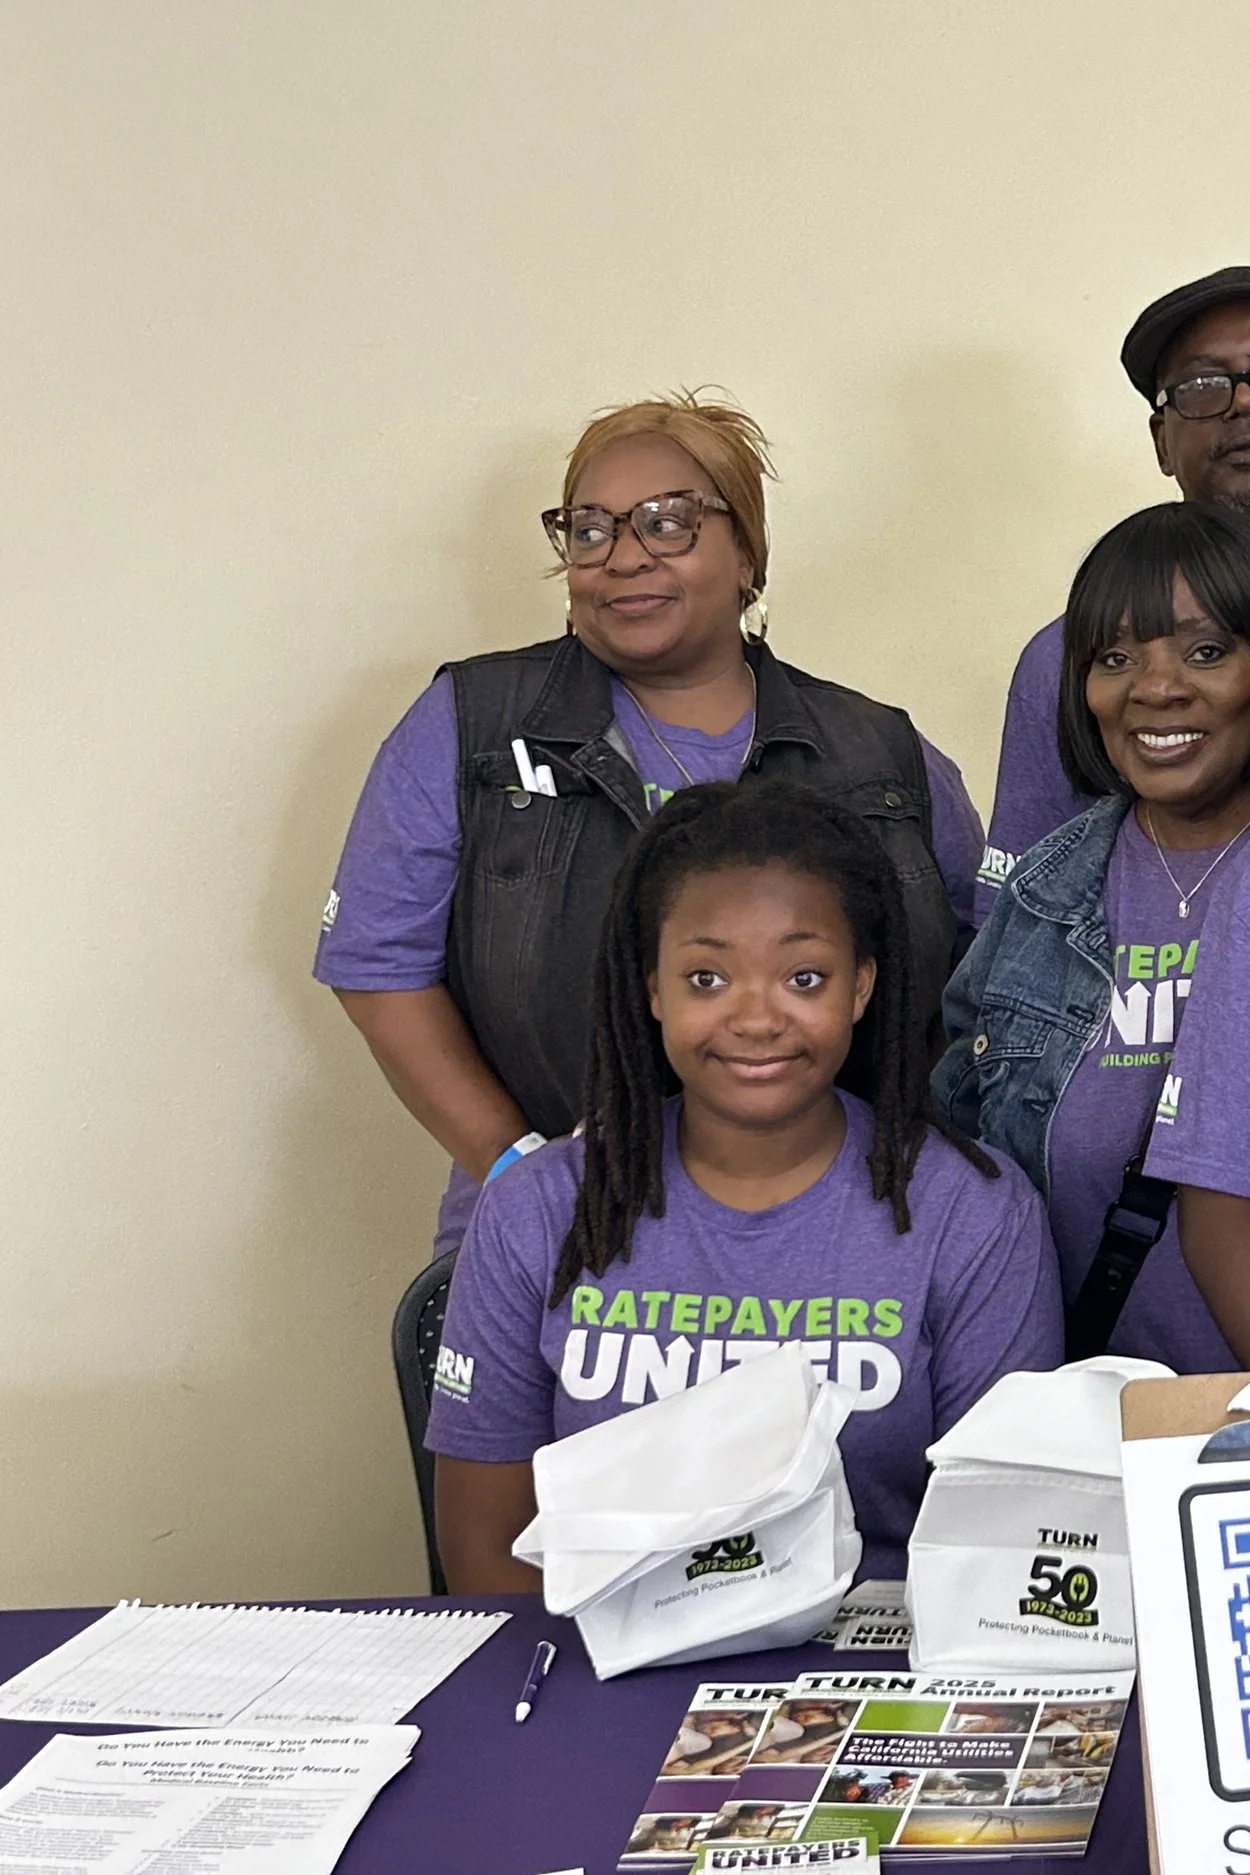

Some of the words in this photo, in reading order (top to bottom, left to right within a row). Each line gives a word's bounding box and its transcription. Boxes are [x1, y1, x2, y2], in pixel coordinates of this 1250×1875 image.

[572, 1285, 903, 1338] RATEPAYERS
[1038, 1528, 1099, 1547] TURN
[1027, 1554, 1099, 1610] 50
[1026, 1601, 1093, 1623] 1973-2023
[978, 1617, 1030, 1635] Protecting
[1031, 1624, 1090, 1641] Pocketbook
[805, 1676, 917, 1689] TURN
[919, 1686, 1017, 1697] Annual
[1022, 1685, 1117, 1698] Report
[154, 1740, 192, 1748] Have
[224, 1739, 275, 1748] Energy
[848, 1745, 938, 1757] California
[852, 1737, 885, 1746] The
[888, 1738, 935, 1748] Fight
[940, 1740, 958, 1748] to
[961, 1739, 1011, 1749] Make
[218, 1762, 269, 1774] Energy
[302, 1765, 343, 1774] Need
[712, 1840, 861, 1858] RATEPAYERS
[712, 1847, 861, 1869] UNITED
